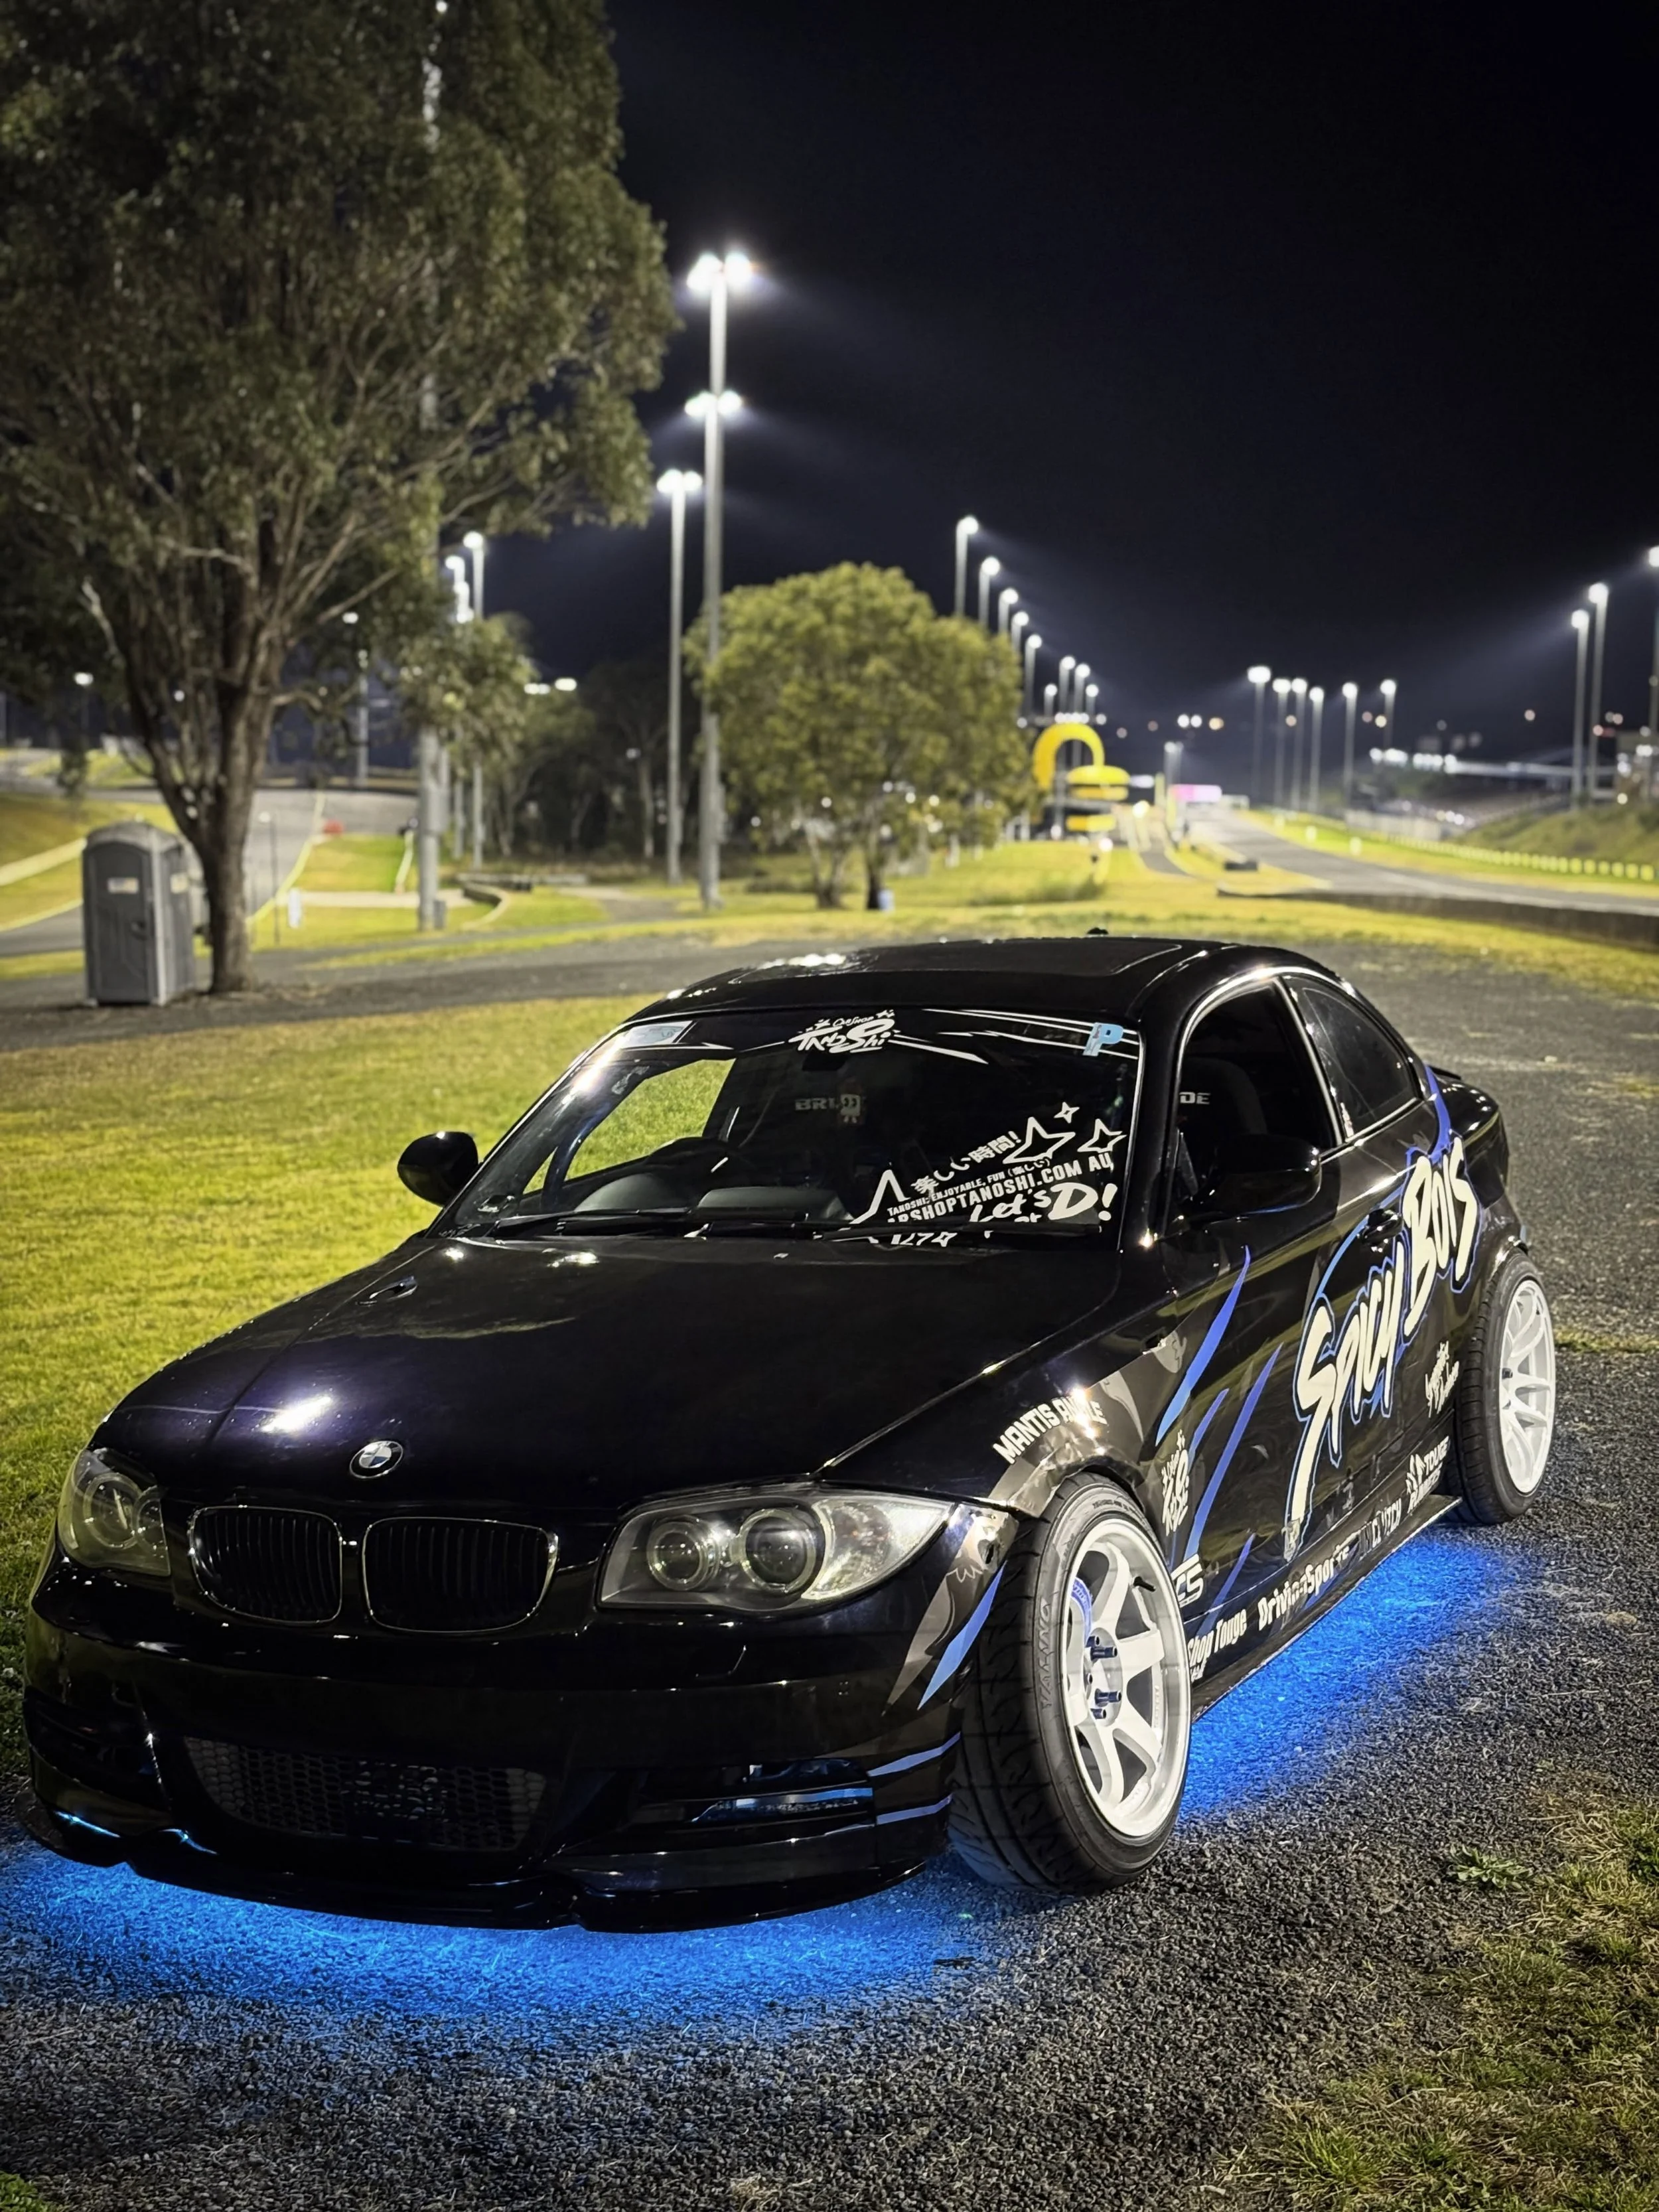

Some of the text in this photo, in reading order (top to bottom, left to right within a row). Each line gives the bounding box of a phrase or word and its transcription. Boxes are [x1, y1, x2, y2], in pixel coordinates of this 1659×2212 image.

[1082, 1022, 1123, 1057] P
[796, 1097, 839, 1111] BRI
[932, 1178, 986, 1202] ENJOYABLE,
[987, 1171, 1005, 1184] FUN
[993, 1392, 1108, 1464] MANTIS ANLE
[1214, 1609, 1247, 1653] Touge
